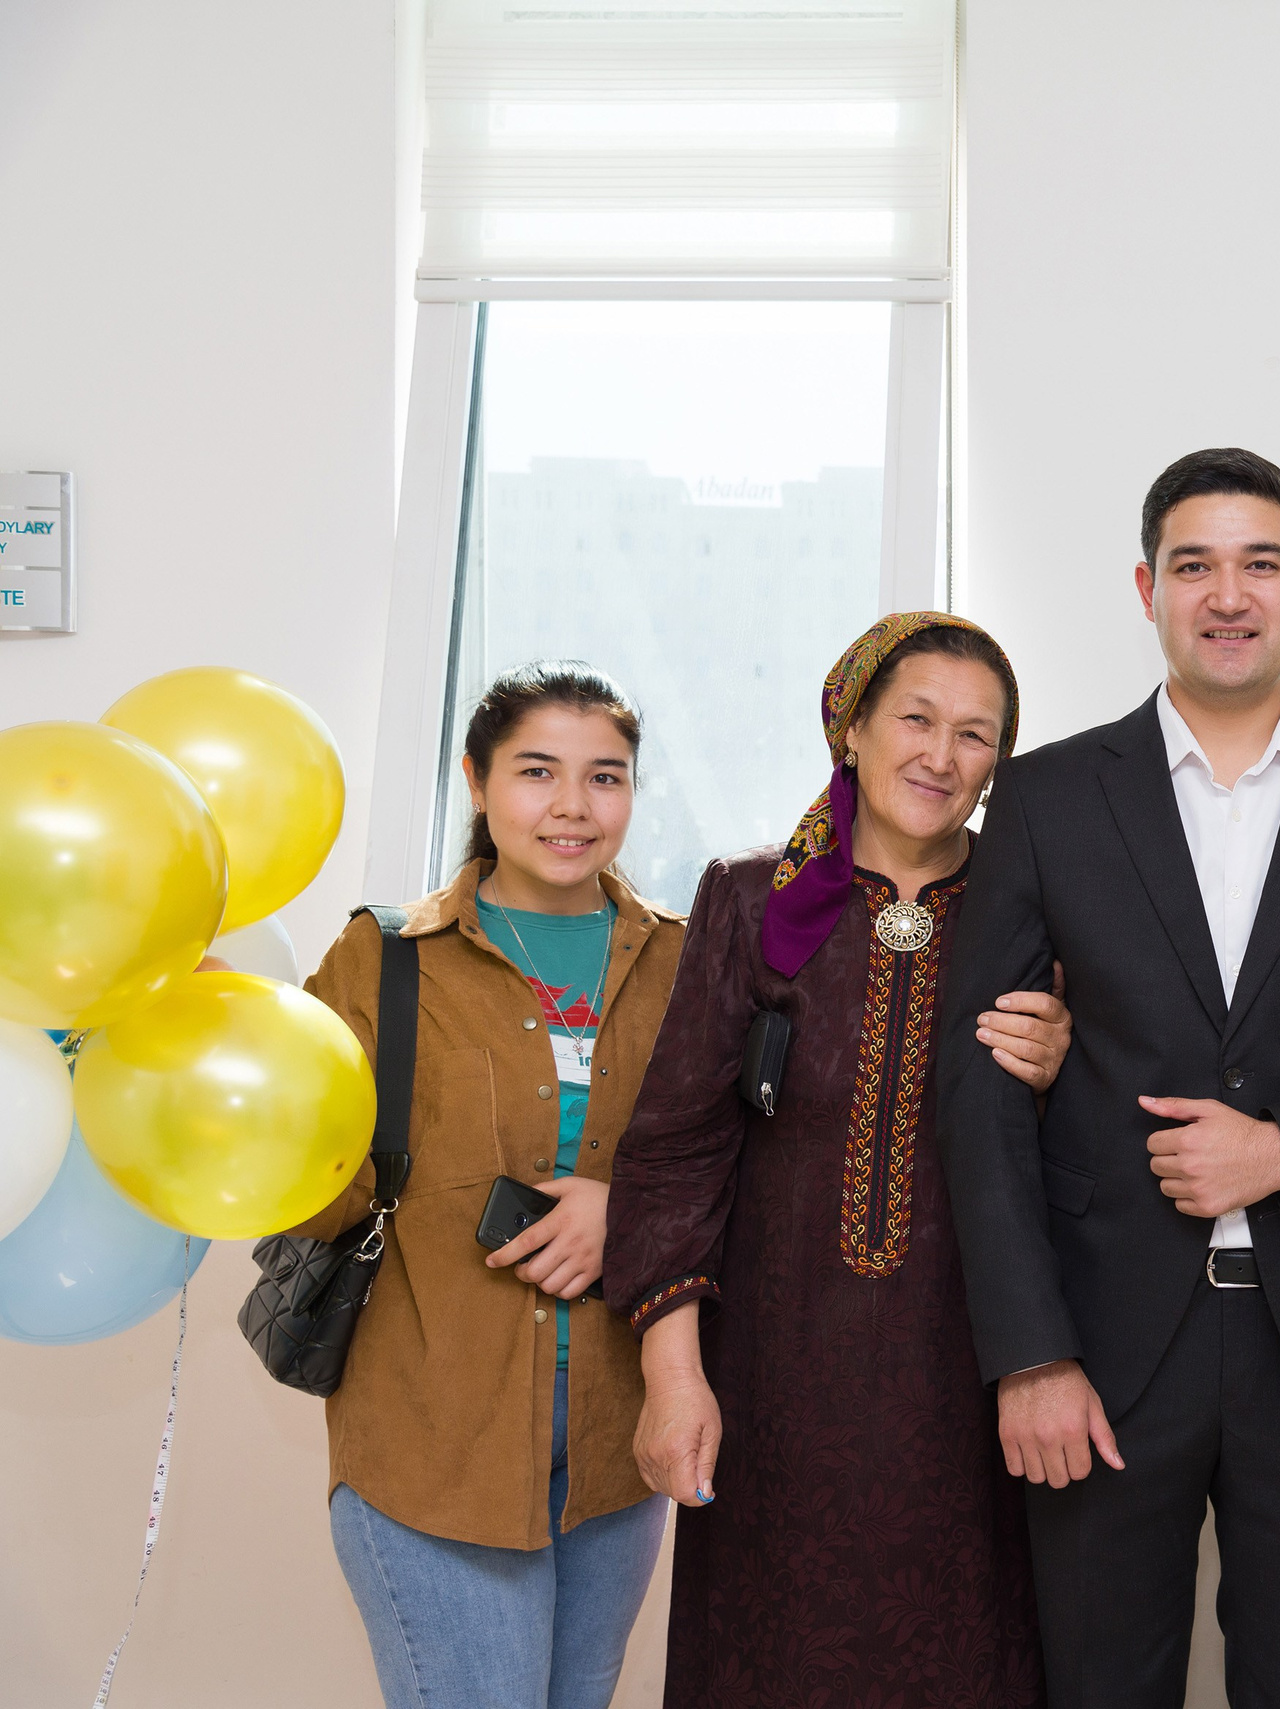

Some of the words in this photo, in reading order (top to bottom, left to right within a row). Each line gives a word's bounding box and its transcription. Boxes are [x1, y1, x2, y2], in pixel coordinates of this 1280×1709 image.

[161, 1437, 169, 1450] 46
[157, 1463, 165, 1476] 47
[152, 1489, 161, 1503] 48
[148, 1516, 156, 1529] 49
[145, 1542, 153, 1556] 50
